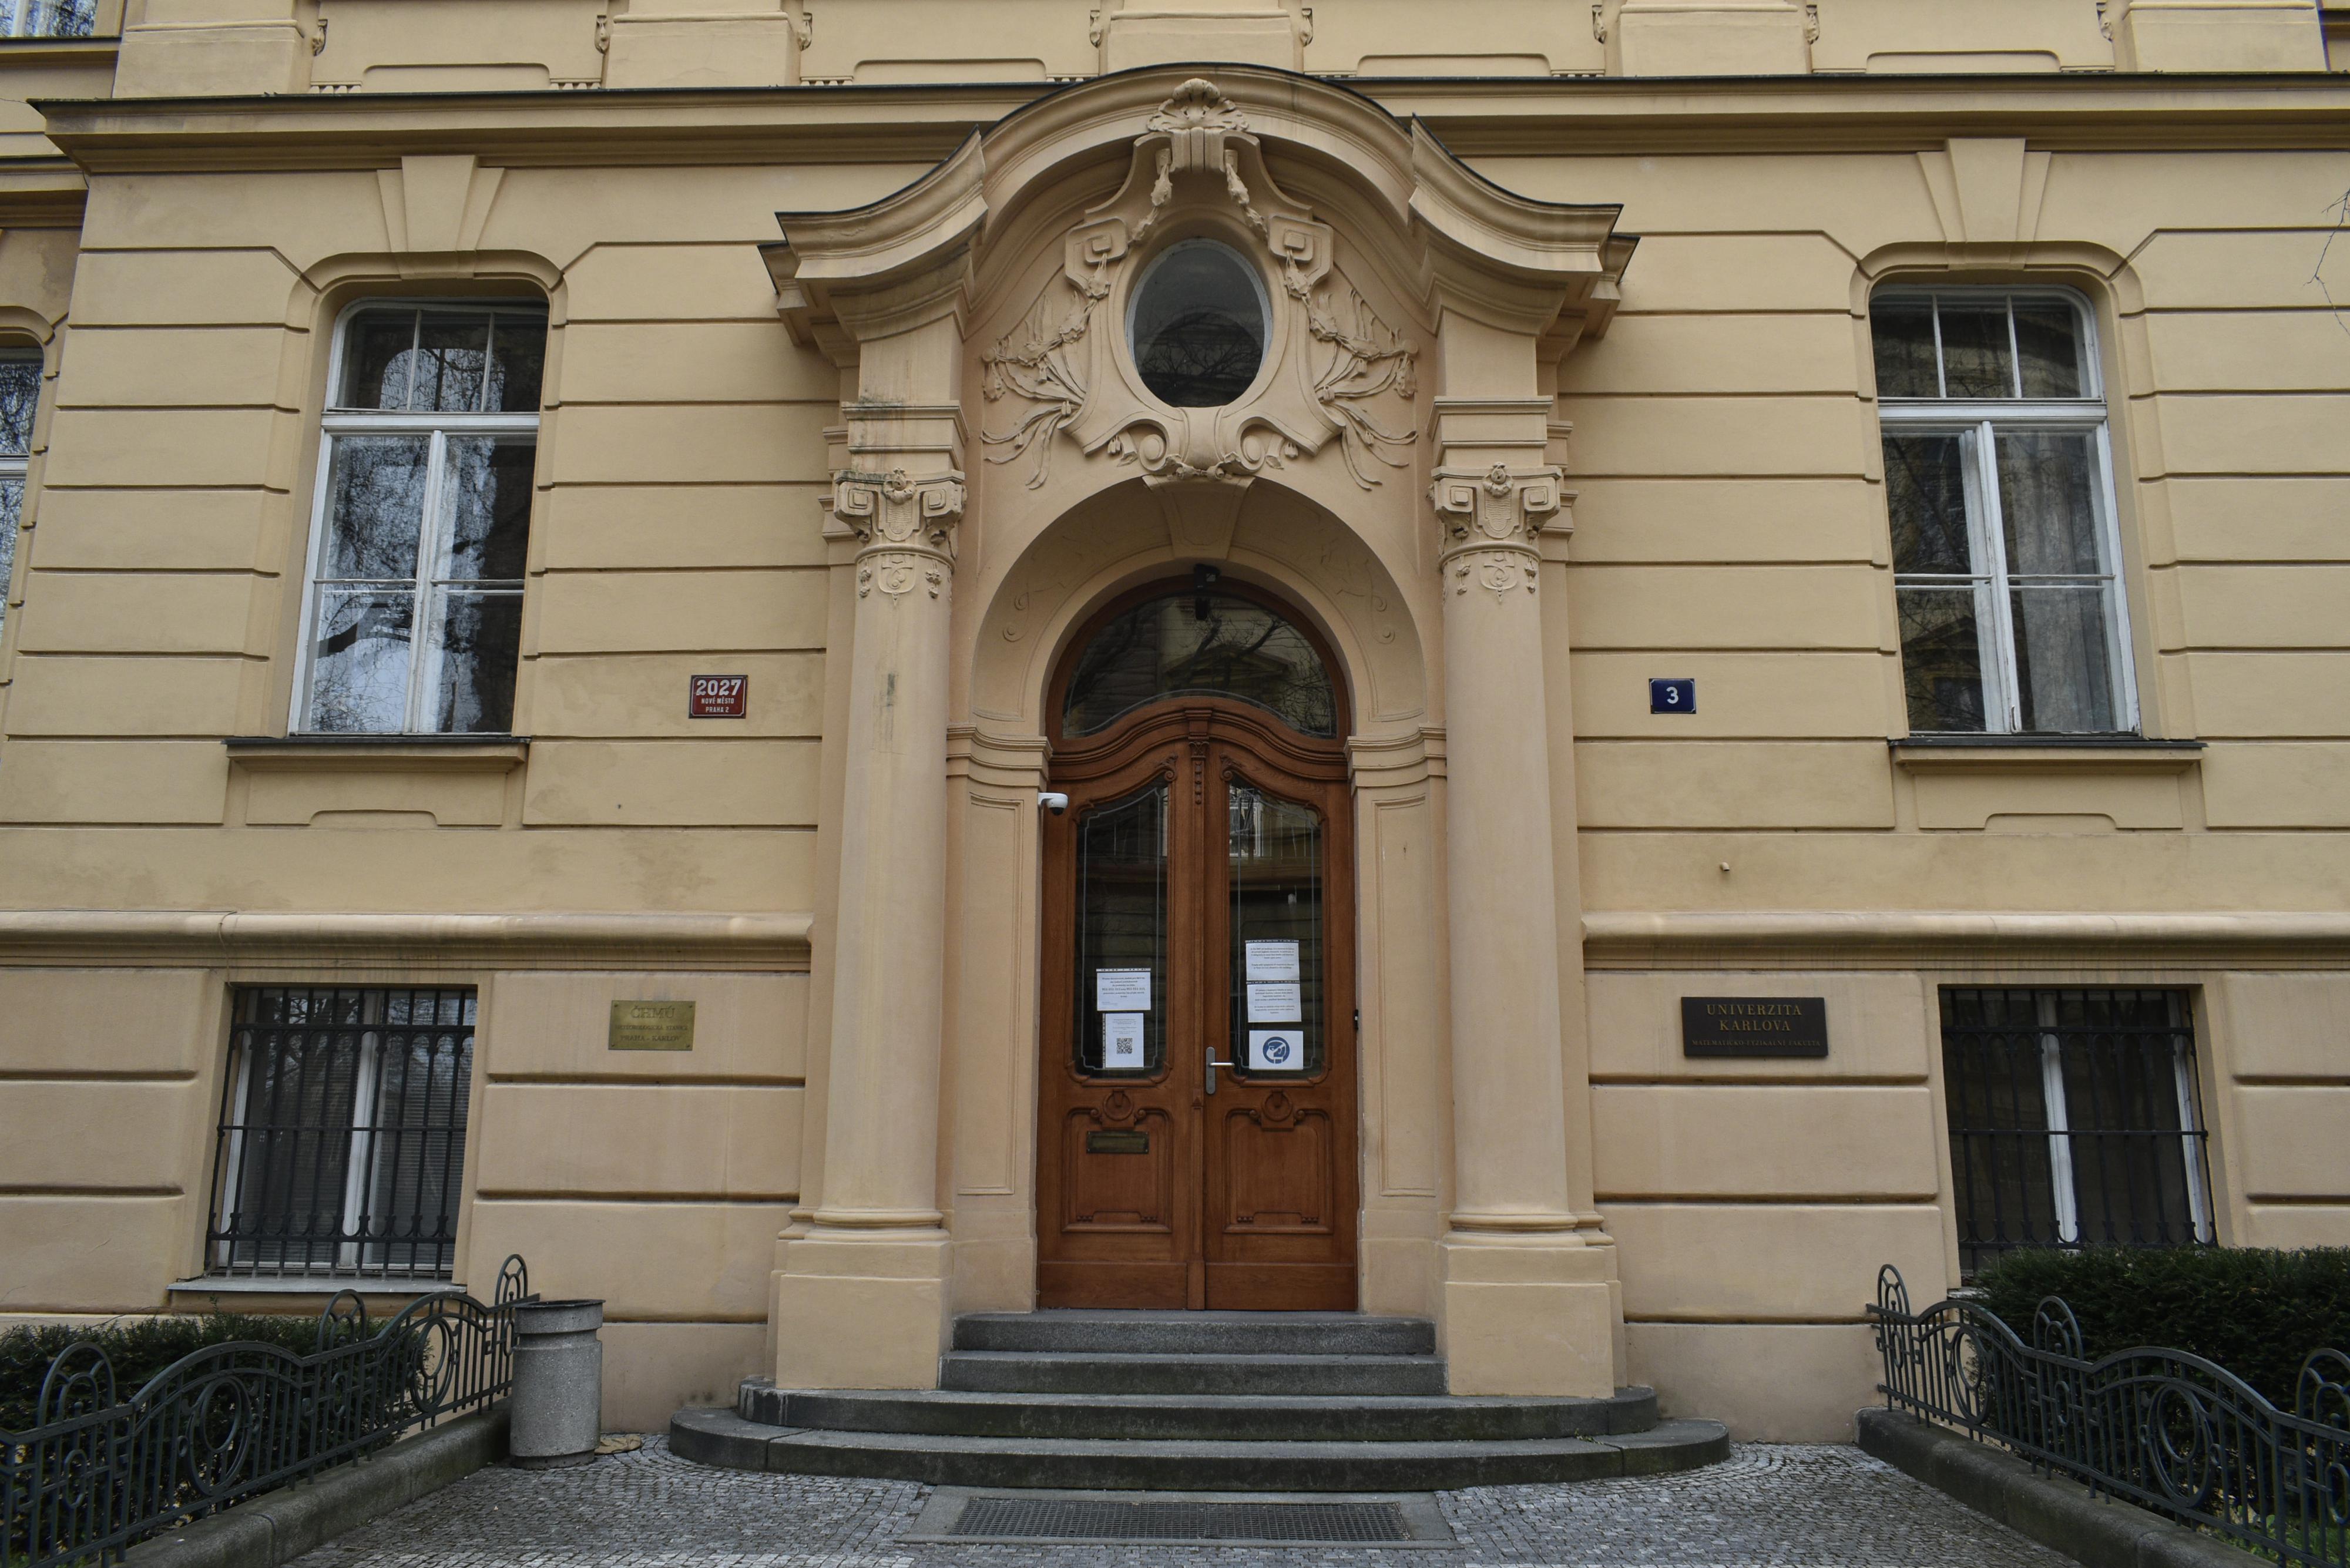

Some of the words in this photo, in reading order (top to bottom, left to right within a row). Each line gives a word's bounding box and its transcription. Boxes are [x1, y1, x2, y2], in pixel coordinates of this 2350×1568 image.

[696, 679, 741, 696] 2027
[1666, 686, 1679, 704] 3
[630, 1005, 675, 1019] ČHMÚ
[1706, 1004, 1802, 1016] UNIVERZITA
[1720, 1020, 1791, 1031] KARLOVA
